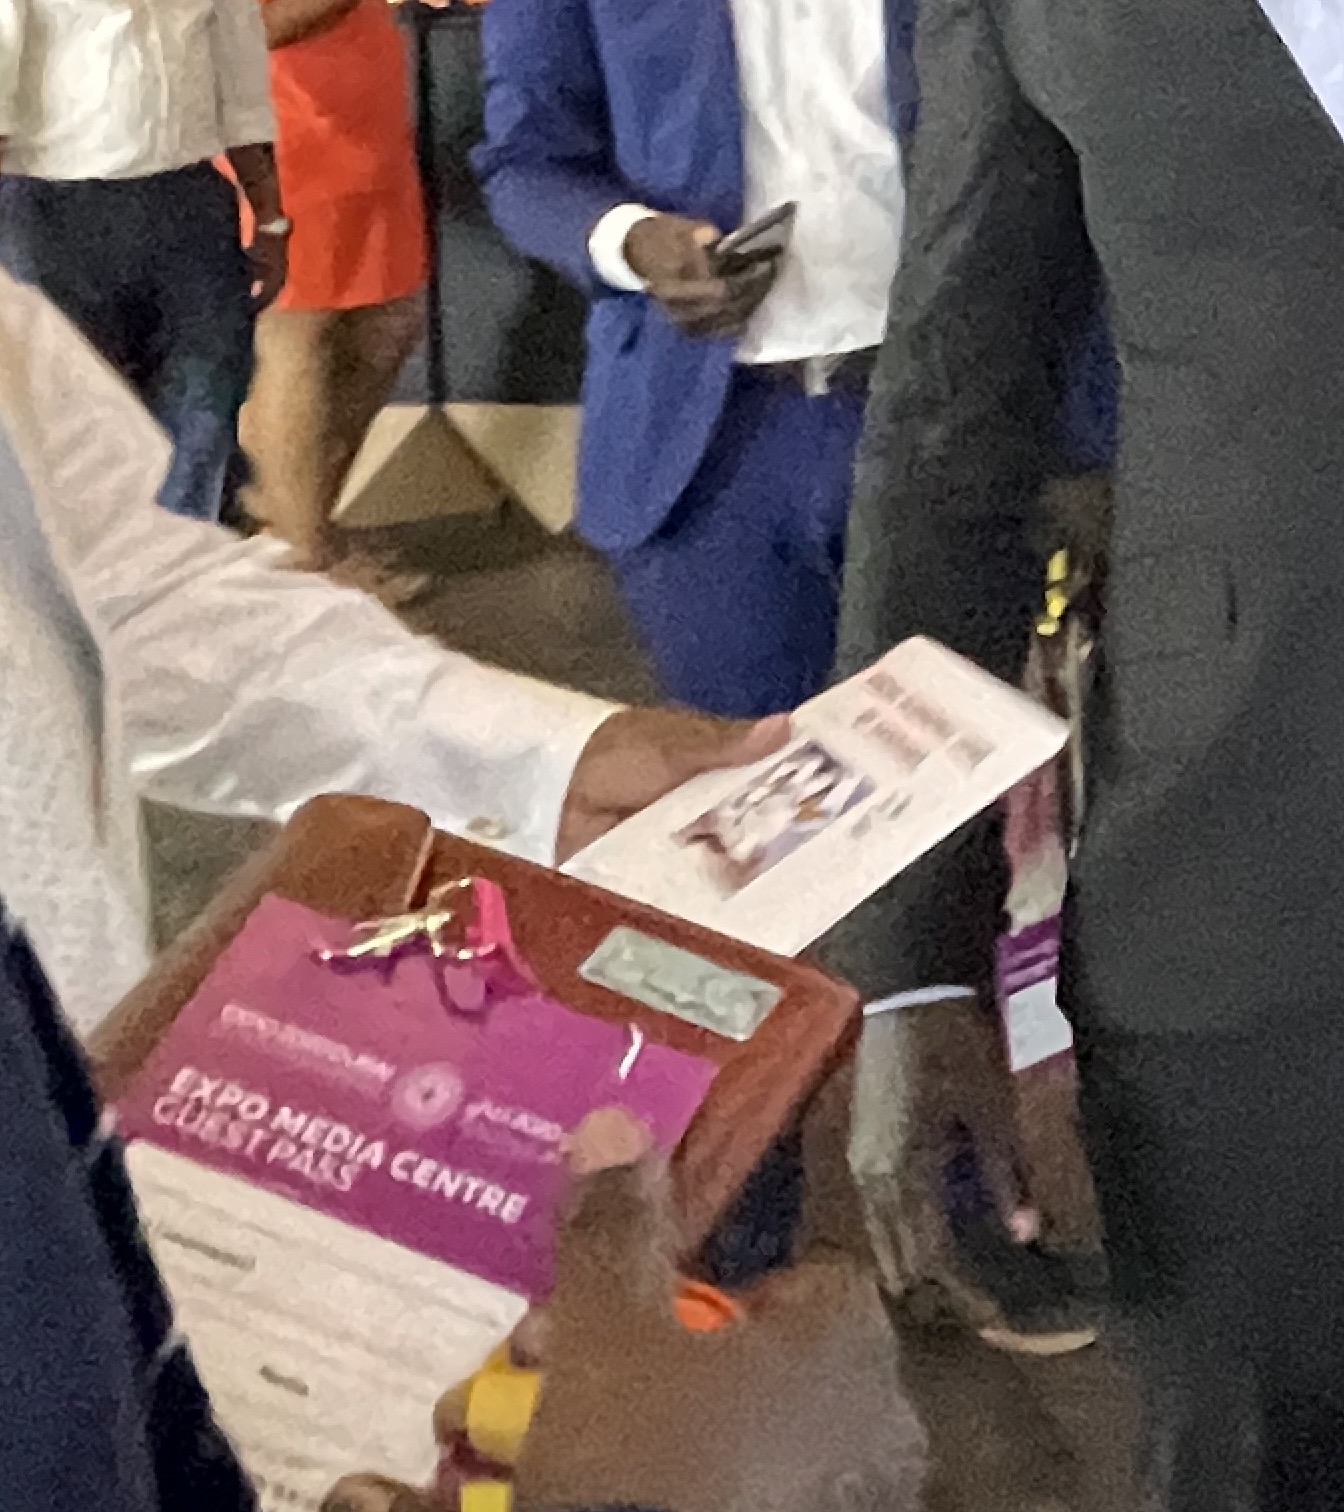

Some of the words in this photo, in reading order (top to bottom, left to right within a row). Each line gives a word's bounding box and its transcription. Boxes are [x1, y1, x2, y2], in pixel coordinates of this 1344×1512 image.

[170, 1065, 270, 1120] EXPO
[269, 1105, 387, 1170] MEDIA
[390, 1149, 530, 1225] CENTRE
